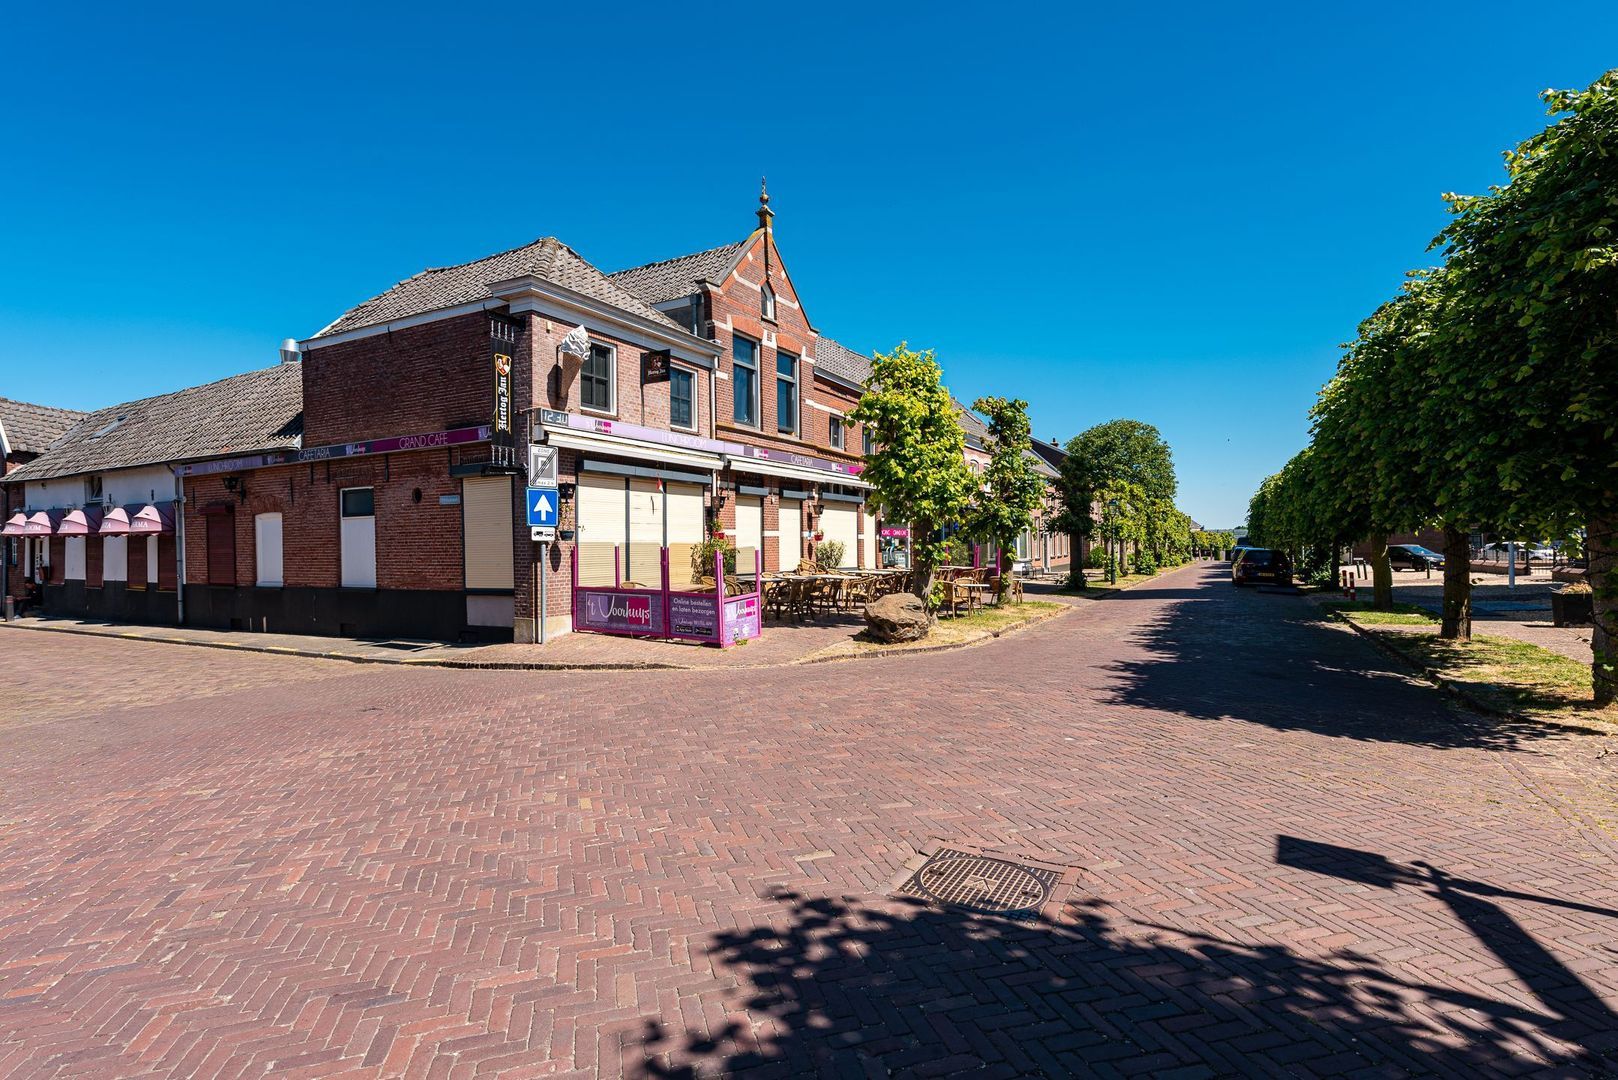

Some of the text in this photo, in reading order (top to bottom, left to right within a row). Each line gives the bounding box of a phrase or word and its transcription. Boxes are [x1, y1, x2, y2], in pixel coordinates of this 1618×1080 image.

[498, 377, 510, 431] Hertog Jan
[399, 435, 426, 449] GRAND
[298, 447, 331, 461] CAFETARIA
[673, 597, 690, 606] Online
[679, 605, 691, 613] laten
[691, 607, 716, 616] bezorgen
